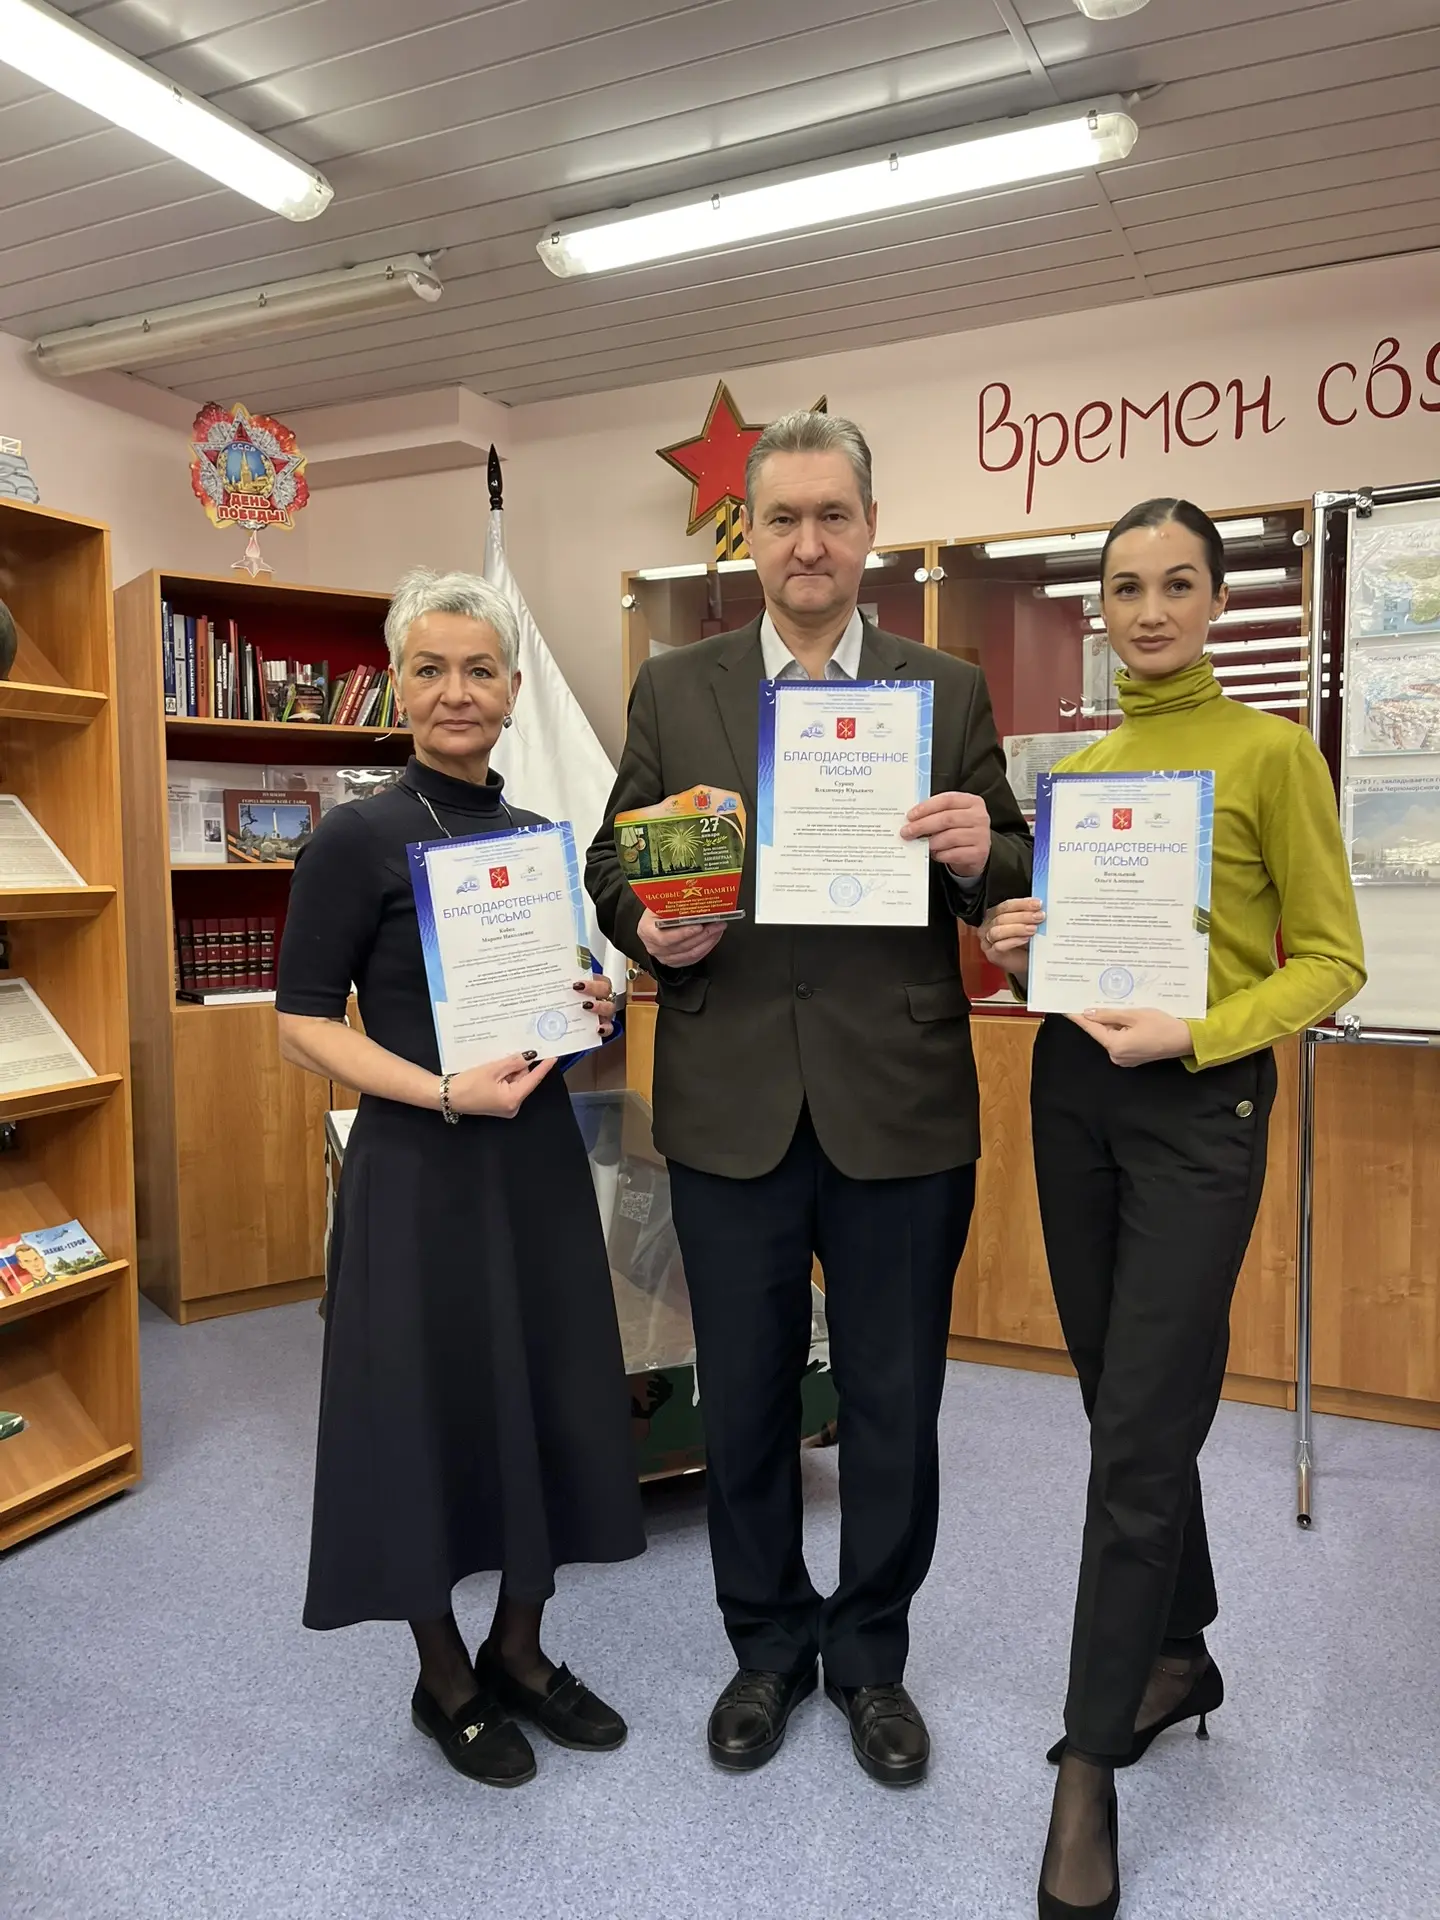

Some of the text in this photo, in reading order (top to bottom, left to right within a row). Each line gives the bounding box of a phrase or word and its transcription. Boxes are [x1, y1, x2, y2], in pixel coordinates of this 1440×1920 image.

[231, 494, 270, 508] ДЕНЬ
[783, 751, 909, 763] БЛАГОДАРСТВЕННОЕ
[819, 765, 872, 776] ПИСЬМО
[699, 817, 720, 833] 27
[1058, 842, 1188, 854] БЛАГОДАРСТВЕННОЕ
[1093, 855, 1149, 867] ПИСЬМО
[645, 891, 681, 900] ЧАСОВЫЕ
[703, 885, 736, 895] ПАМЯТИ
[443, 890, 563, 919] БЛАГОДАРСТВЕННОЕ
[480, 909, 531, 926] ПИСЬМО
